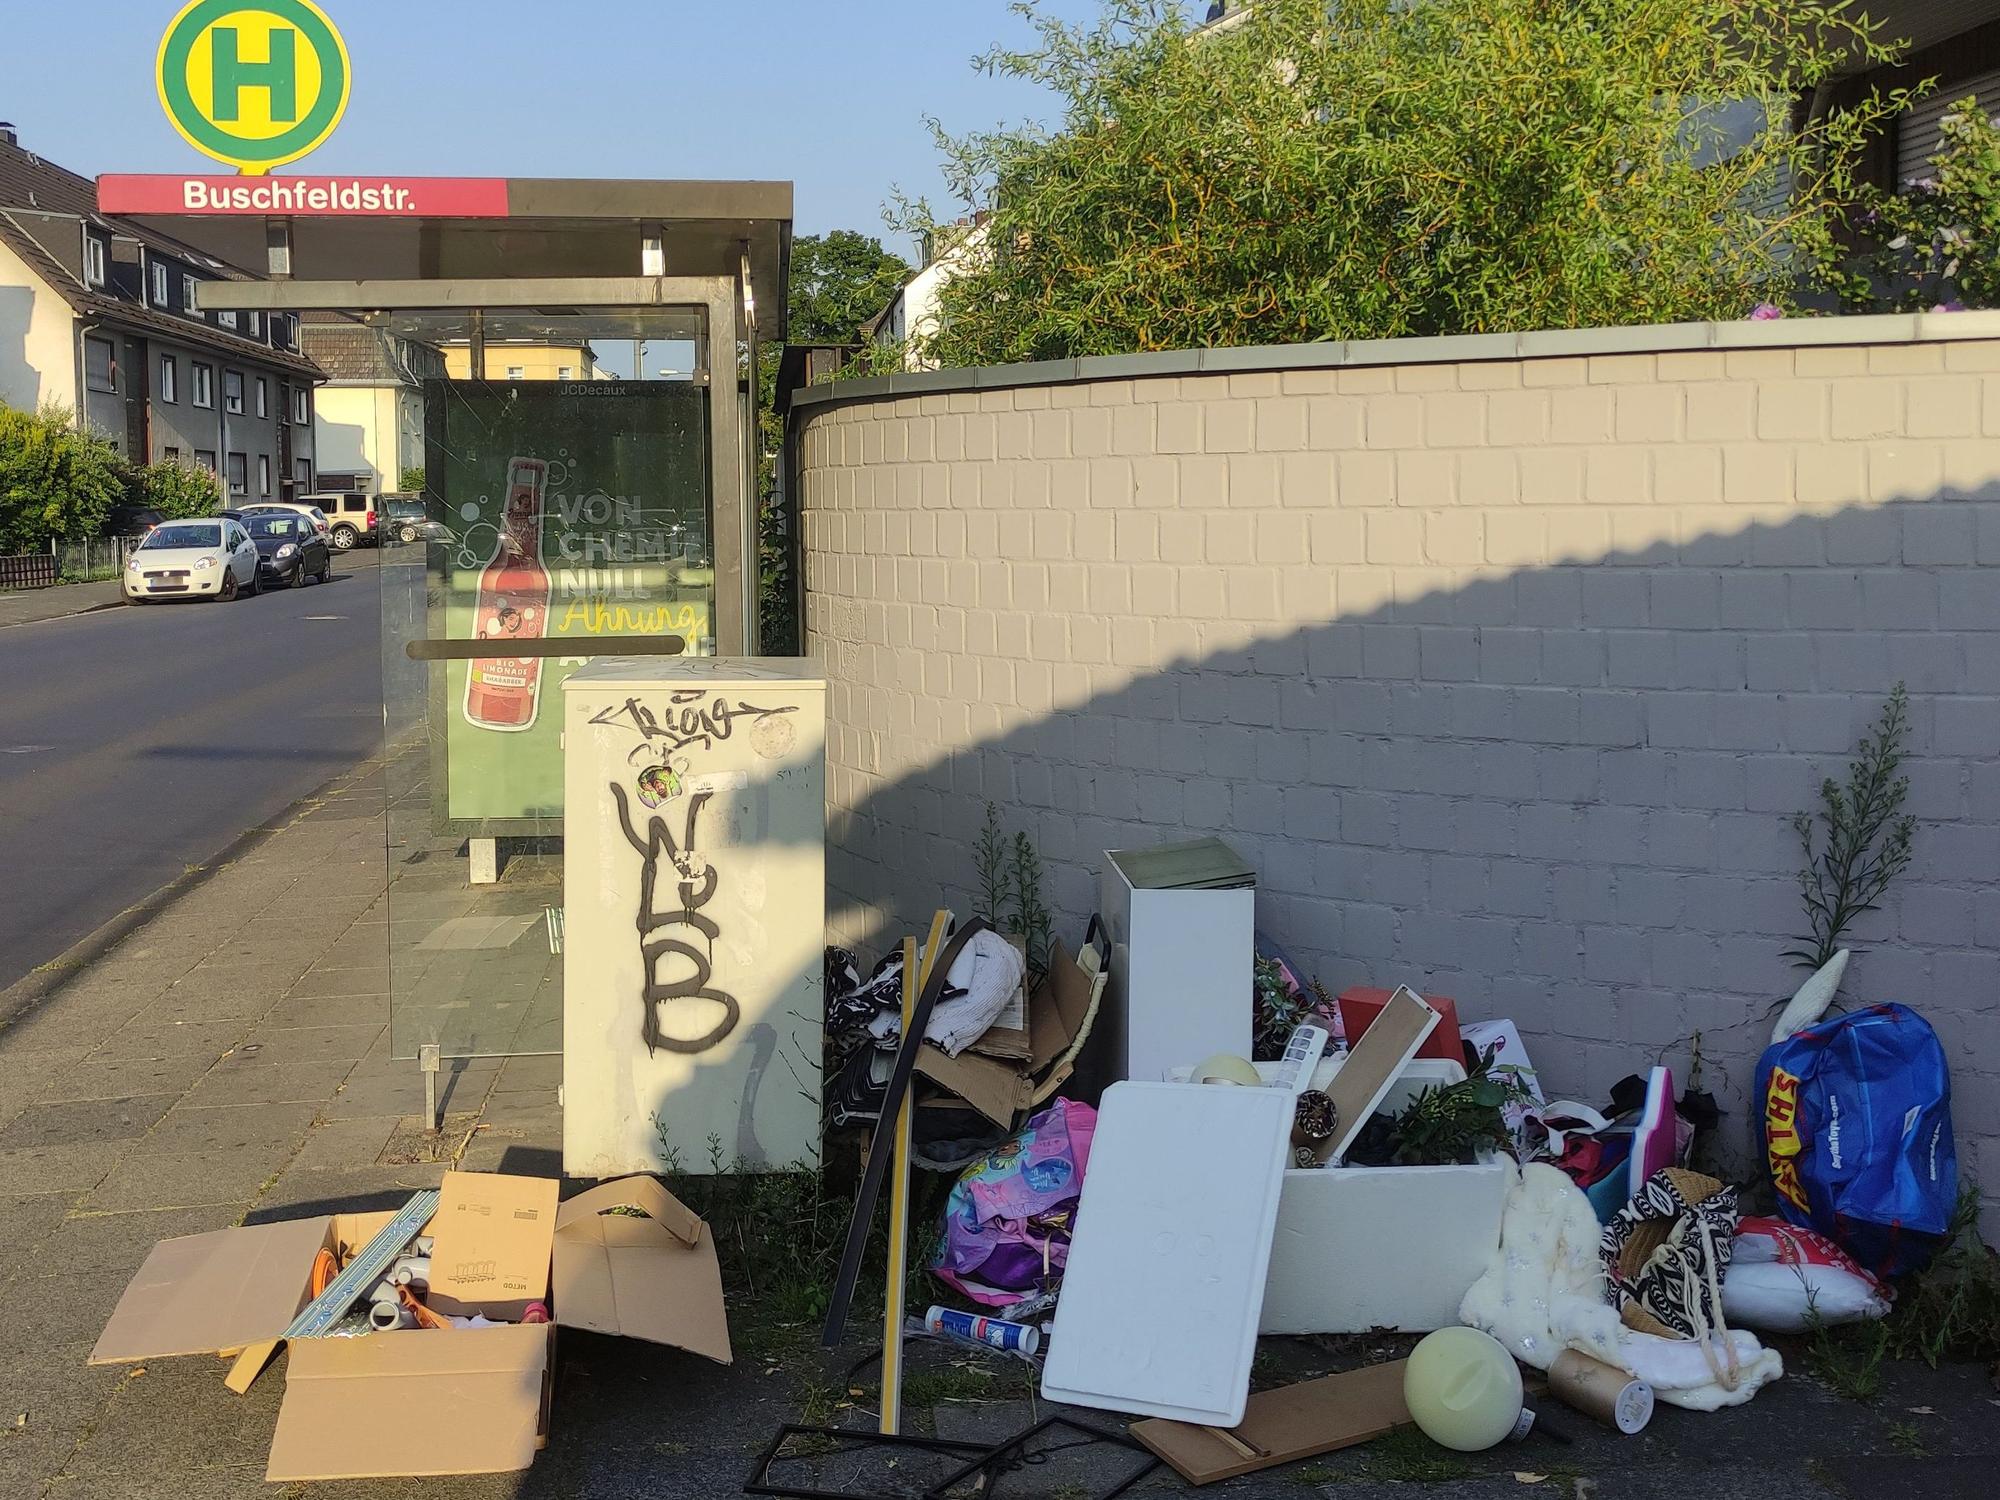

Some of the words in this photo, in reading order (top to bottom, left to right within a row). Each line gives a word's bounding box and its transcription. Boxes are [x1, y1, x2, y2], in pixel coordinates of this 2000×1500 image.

[212, 27, 296, 122] H
[182, 180, 415, 210] Buschfeldstr.
[561, 384, 626, 396] JCDecaux
[557, 494, 641, 525] VON
[558, 531, 702, 563] CHEMIE
[560, 568, 651, 599] NULL
